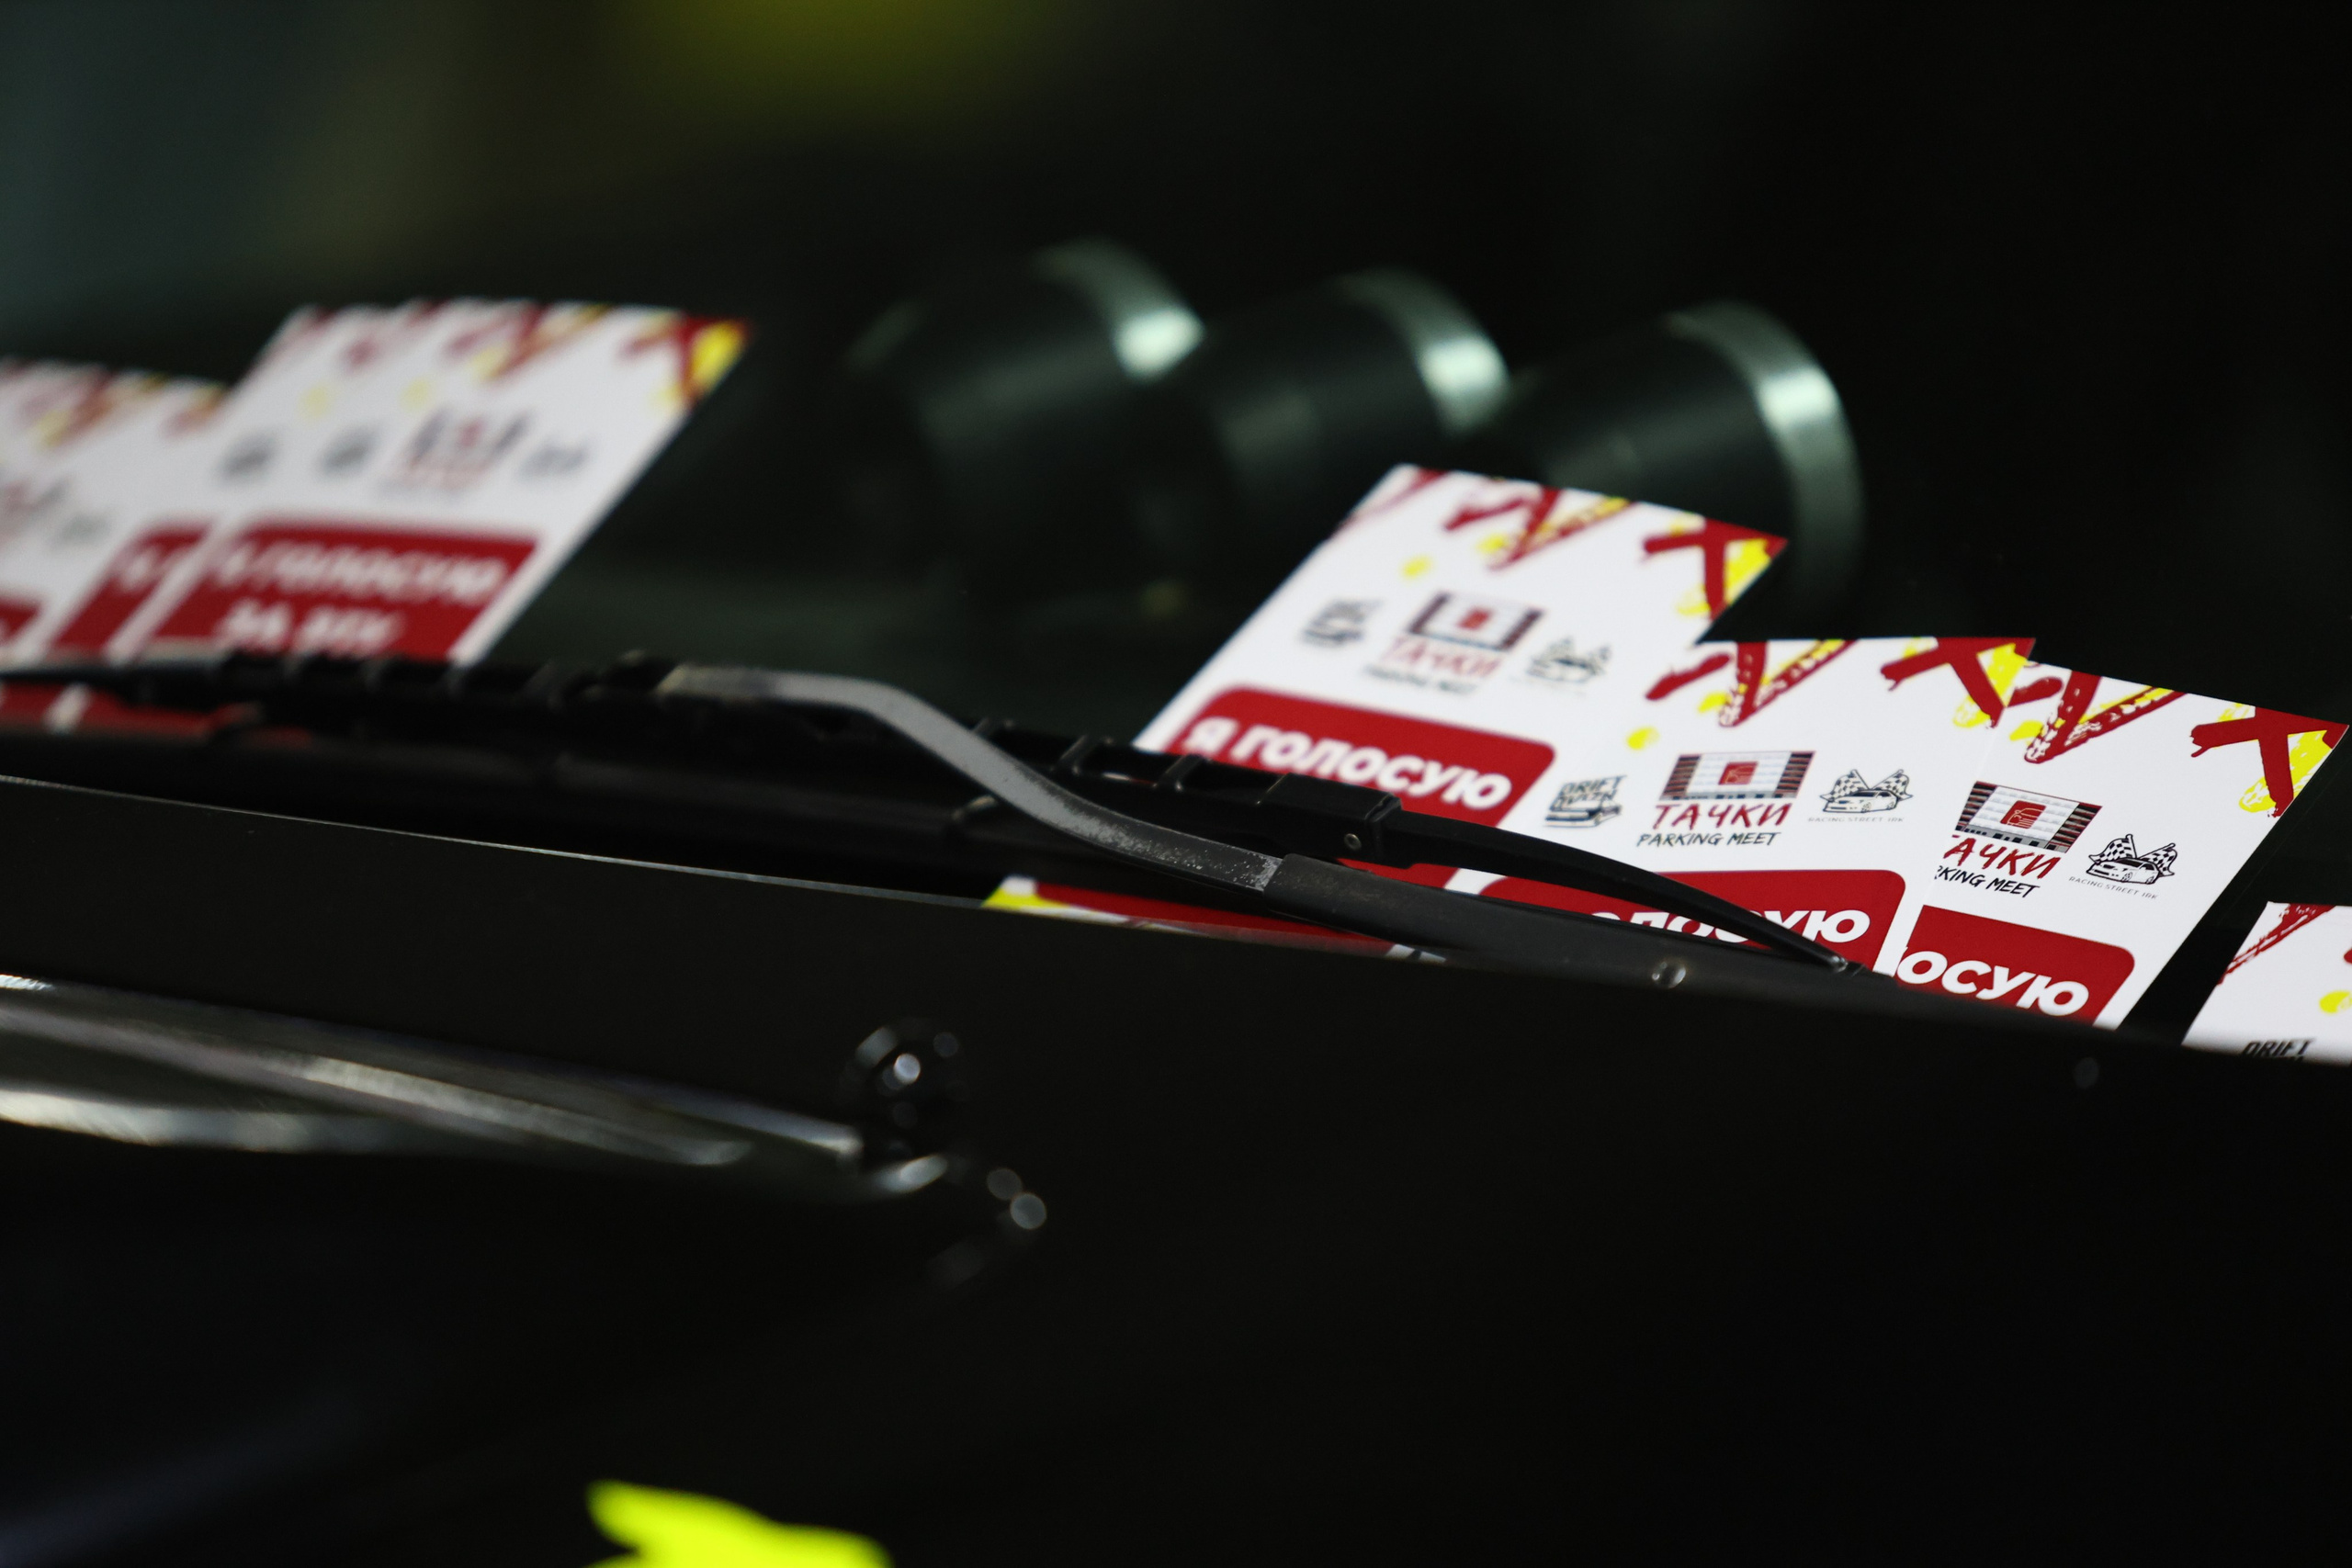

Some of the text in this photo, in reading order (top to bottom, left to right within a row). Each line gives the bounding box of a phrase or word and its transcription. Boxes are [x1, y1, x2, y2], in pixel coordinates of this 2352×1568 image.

[1184, 716, 1513, 809] Я ГОЛОСУЮ
[1652, 803, 1792, 830] ТАЧКИ
[1635, 831, 1782, 847] PARKING MEET
[1942, 834, 2062, 879] АЧКИ
[1935, 864, 2041, 898] KING MEET
[2068, 875, 2158, 900] RACING STREET IRK
[1895, 946, 2090, 1016] ОСУЮ
